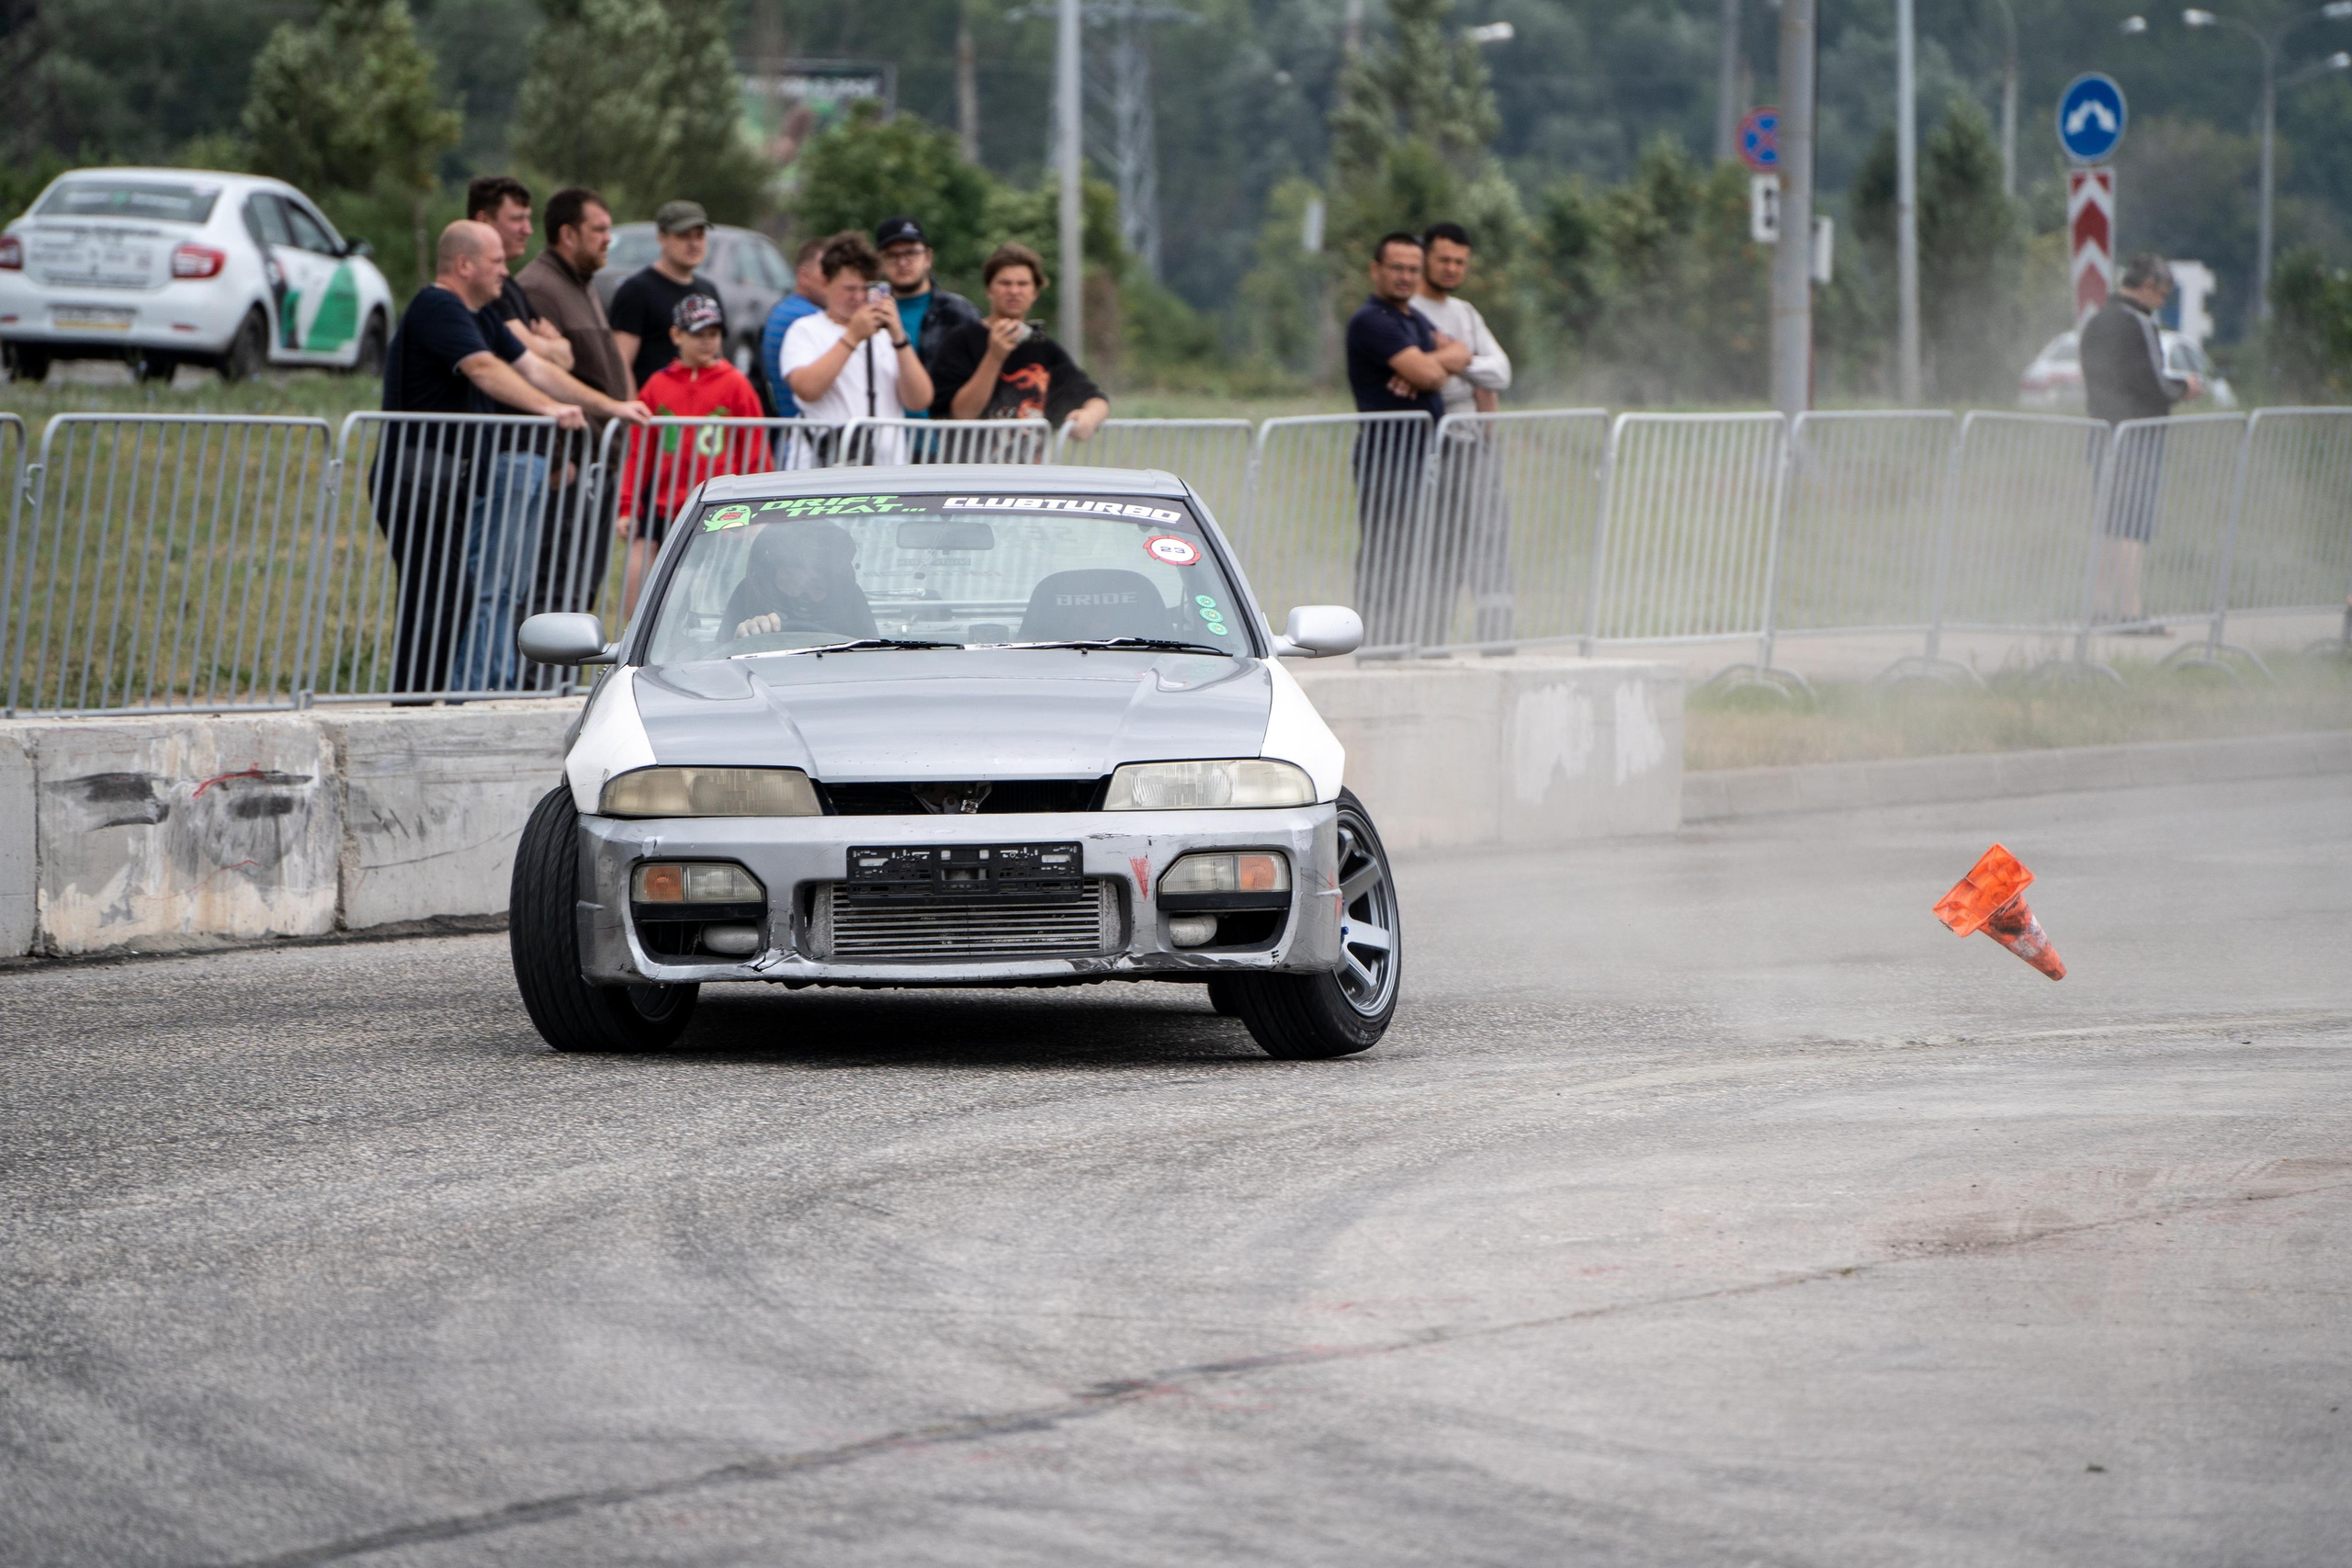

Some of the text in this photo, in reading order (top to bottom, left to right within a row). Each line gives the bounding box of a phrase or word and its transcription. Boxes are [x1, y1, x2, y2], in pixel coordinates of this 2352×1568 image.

[760, 495, 899, 511] DRIFT
[786, 503, 926, 517] THAT...
[943, 497, 1182, 524] CLUBTURBO
[1159, 546, 1185, 554] 23
[1057, 592, 1138, 605] BRIDE
